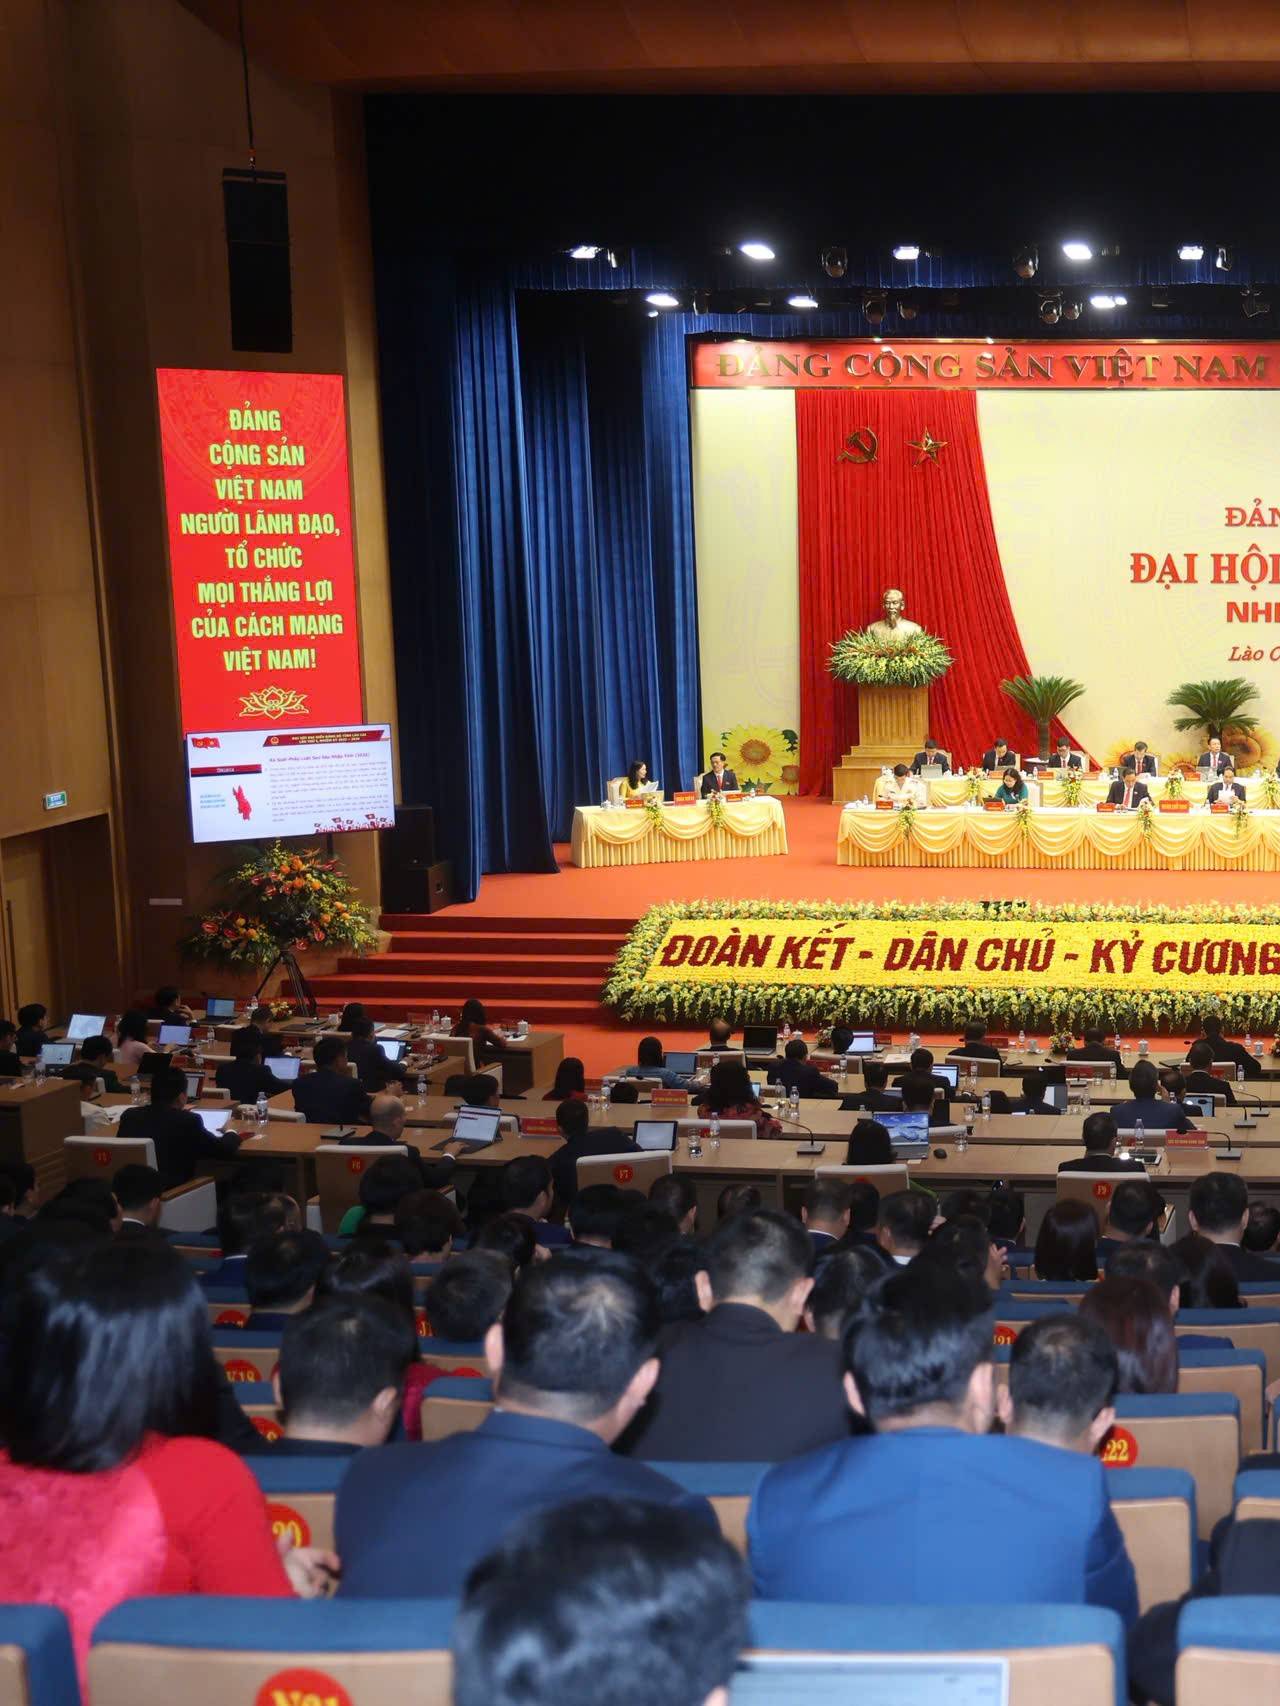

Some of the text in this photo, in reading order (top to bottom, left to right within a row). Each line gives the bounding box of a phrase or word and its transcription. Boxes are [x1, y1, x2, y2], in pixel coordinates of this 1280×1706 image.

[716, 346, 831, 377] ĐẢNG
[844, 347, 963, 384] CỘNG
[975, 346, 1053, 380] SẢN
[1065, 348, 1162, 386] VIỆT
[1174, 355, 1271, 381] NAM
[229, 401, 281, 431] ĐẢNG
[210, 437, 304, 469] CỘNG SẢN
[215, 476, 303, 504] VIỆT NAM
[181, 508, 339, 538] NGƯỜI LÃNH ĐẠO,
[225, 540, 302, 568] TỔ CHỨC
[1131, 553, 1198, 590] ĐẠI
[198, 576, 332, 606] MỌI THẮNG LỢI
[192, 606, 342, 639] CỦA CÁCH MẠNG
[224, 647, 315, 675] VIỆT NAM!
[1228, 647, 1264, 662] Lào
[660, 928, 773, 967] ĐOÀN
[777, 924, 855, 970] KẾT
[884, 931, 968, 971] DÂN
[976, 928, 1055, 972] CHỦ
[1090, 931, 1144, 973] KỶ
